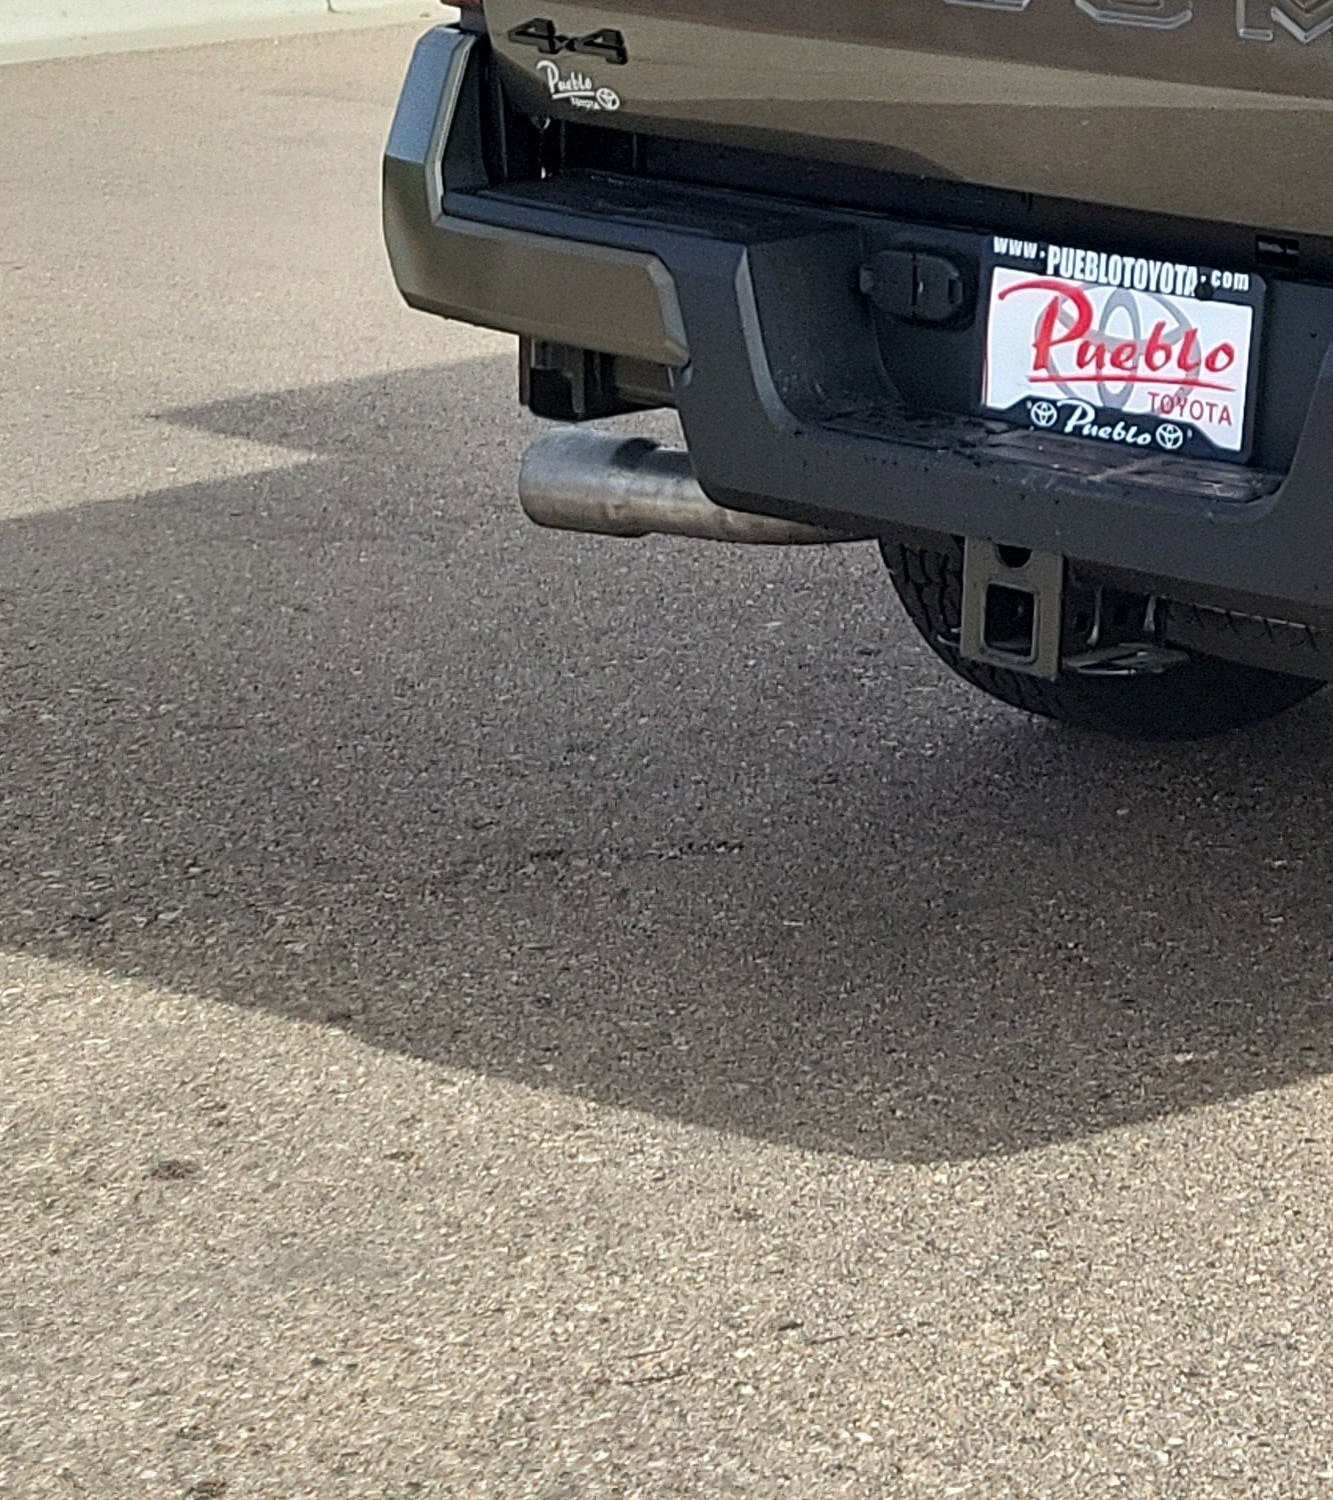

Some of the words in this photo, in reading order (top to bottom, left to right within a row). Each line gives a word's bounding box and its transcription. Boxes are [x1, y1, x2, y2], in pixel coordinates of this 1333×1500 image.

[536, 60, 593, 93] Pueblo
[998, 279, 1236, 374] Pueblo
[1056, 400, 1152, 445] Pueblo
[1148, 390, 1233, 426] TOYOTA
